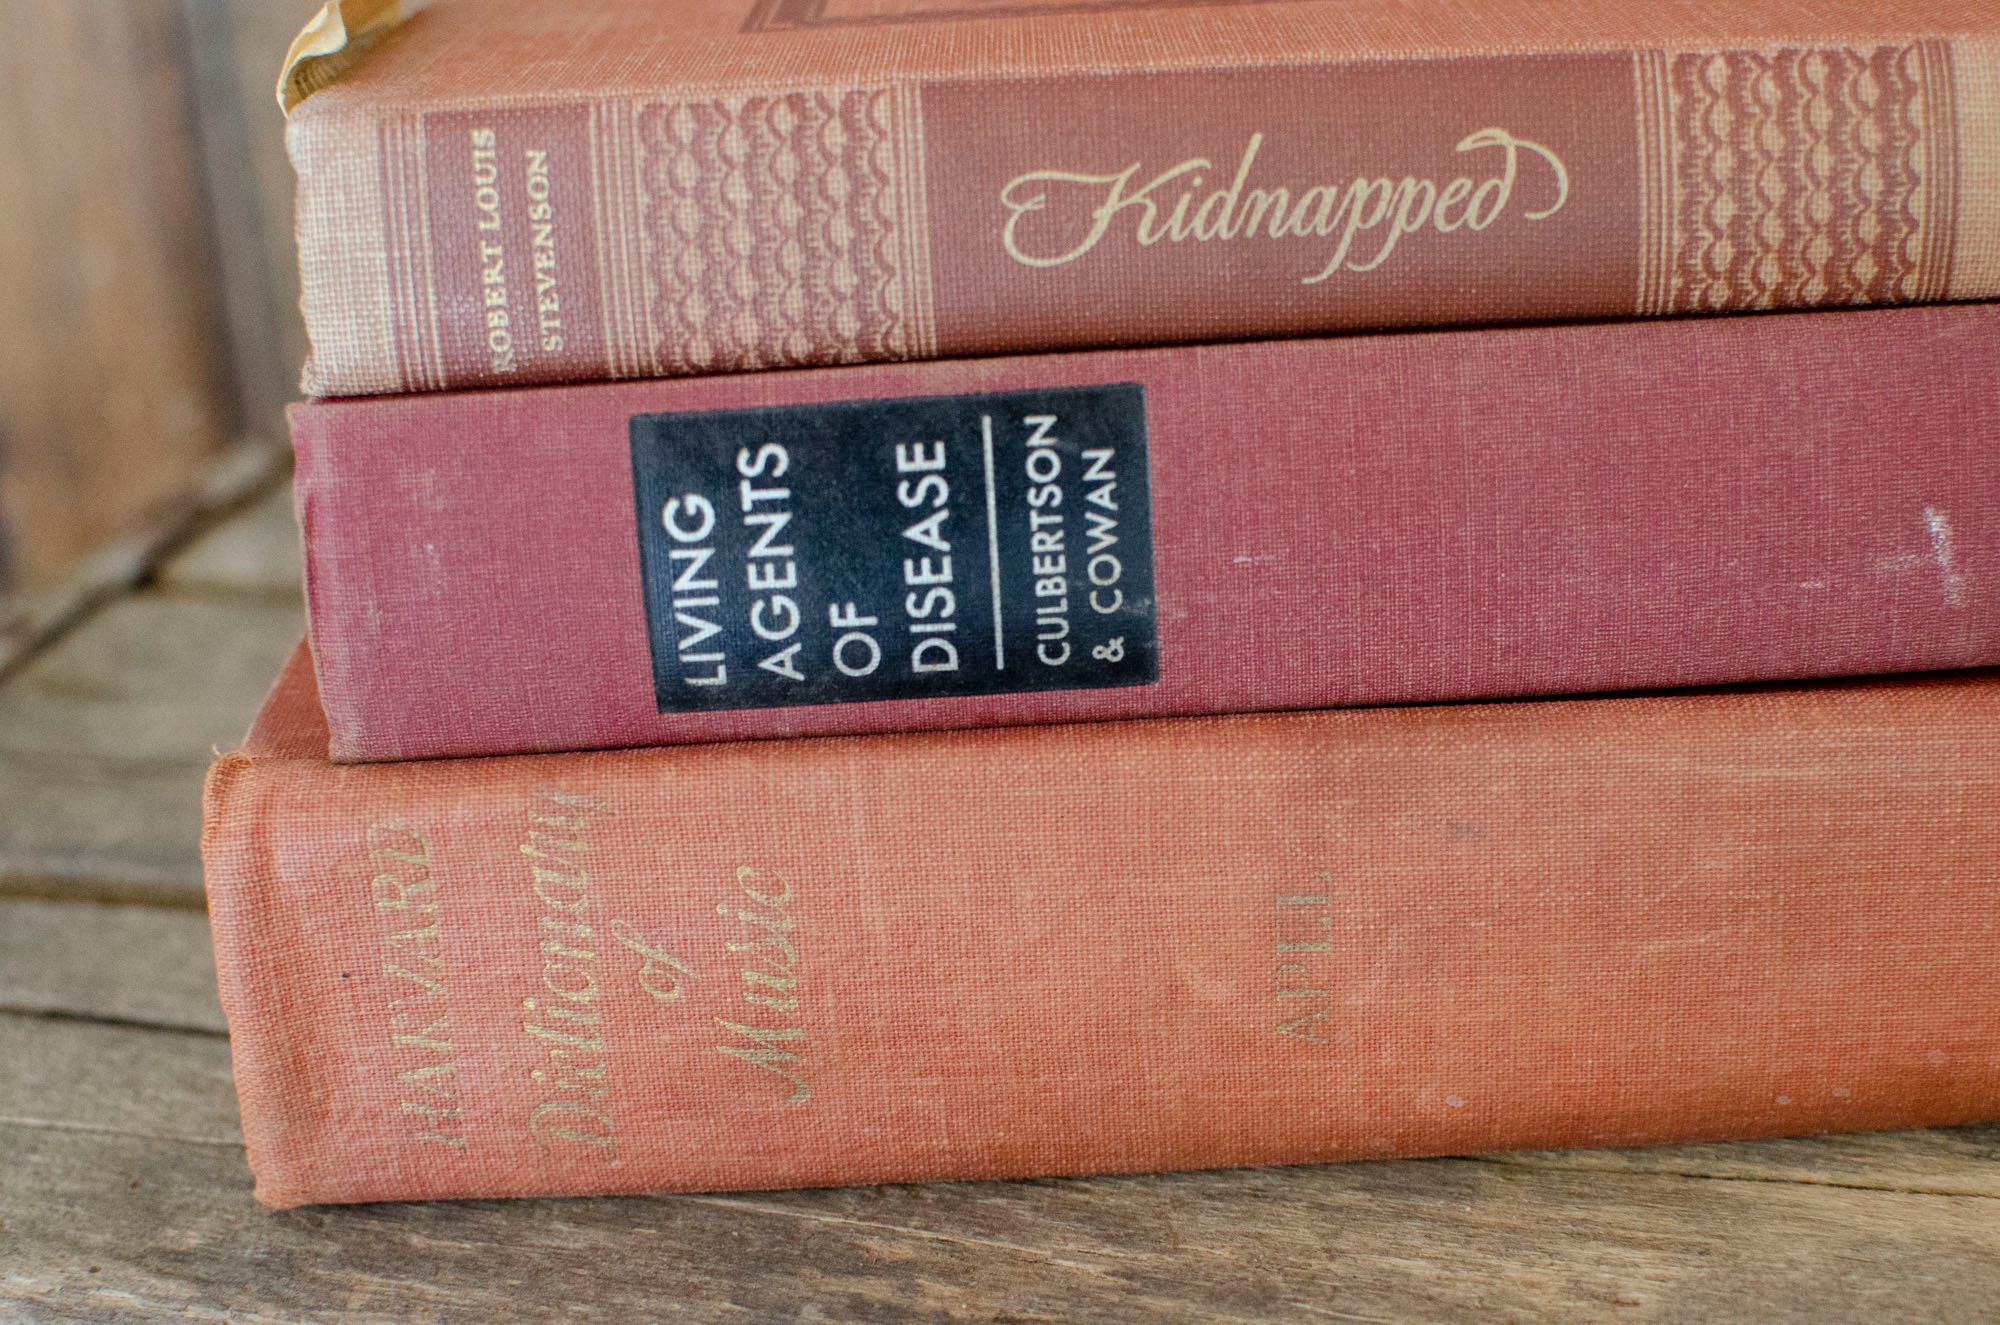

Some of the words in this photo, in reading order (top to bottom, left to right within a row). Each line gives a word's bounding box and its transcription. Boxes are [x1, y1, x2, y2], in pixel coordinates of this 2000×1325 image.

[471, 128, 500, 231] LOUIS
[525, 149, 564, 353] STEVENSON
[1000, 127, 1569, 284] Kidnapped
[480, 240, 517, 373] ROBERT
[662, 492, 728, 687] LIVING
[736, 441, 805, 682] AGENTS
[895, 439, 959, 674] DISEASE
[1023, 414, 1071, 667] CULBERTSON
[1081, 448, 1123, 615] COWAN
[829, 602, 882, 678] OF
[1092, 635, 1126, 664] &
[367, 819, 468, 1153] HARVARD
[610, 918, 700, 999] of
[714, 865, 811, 1103] Music
[1276, 871, 1332, 1044] APEL
